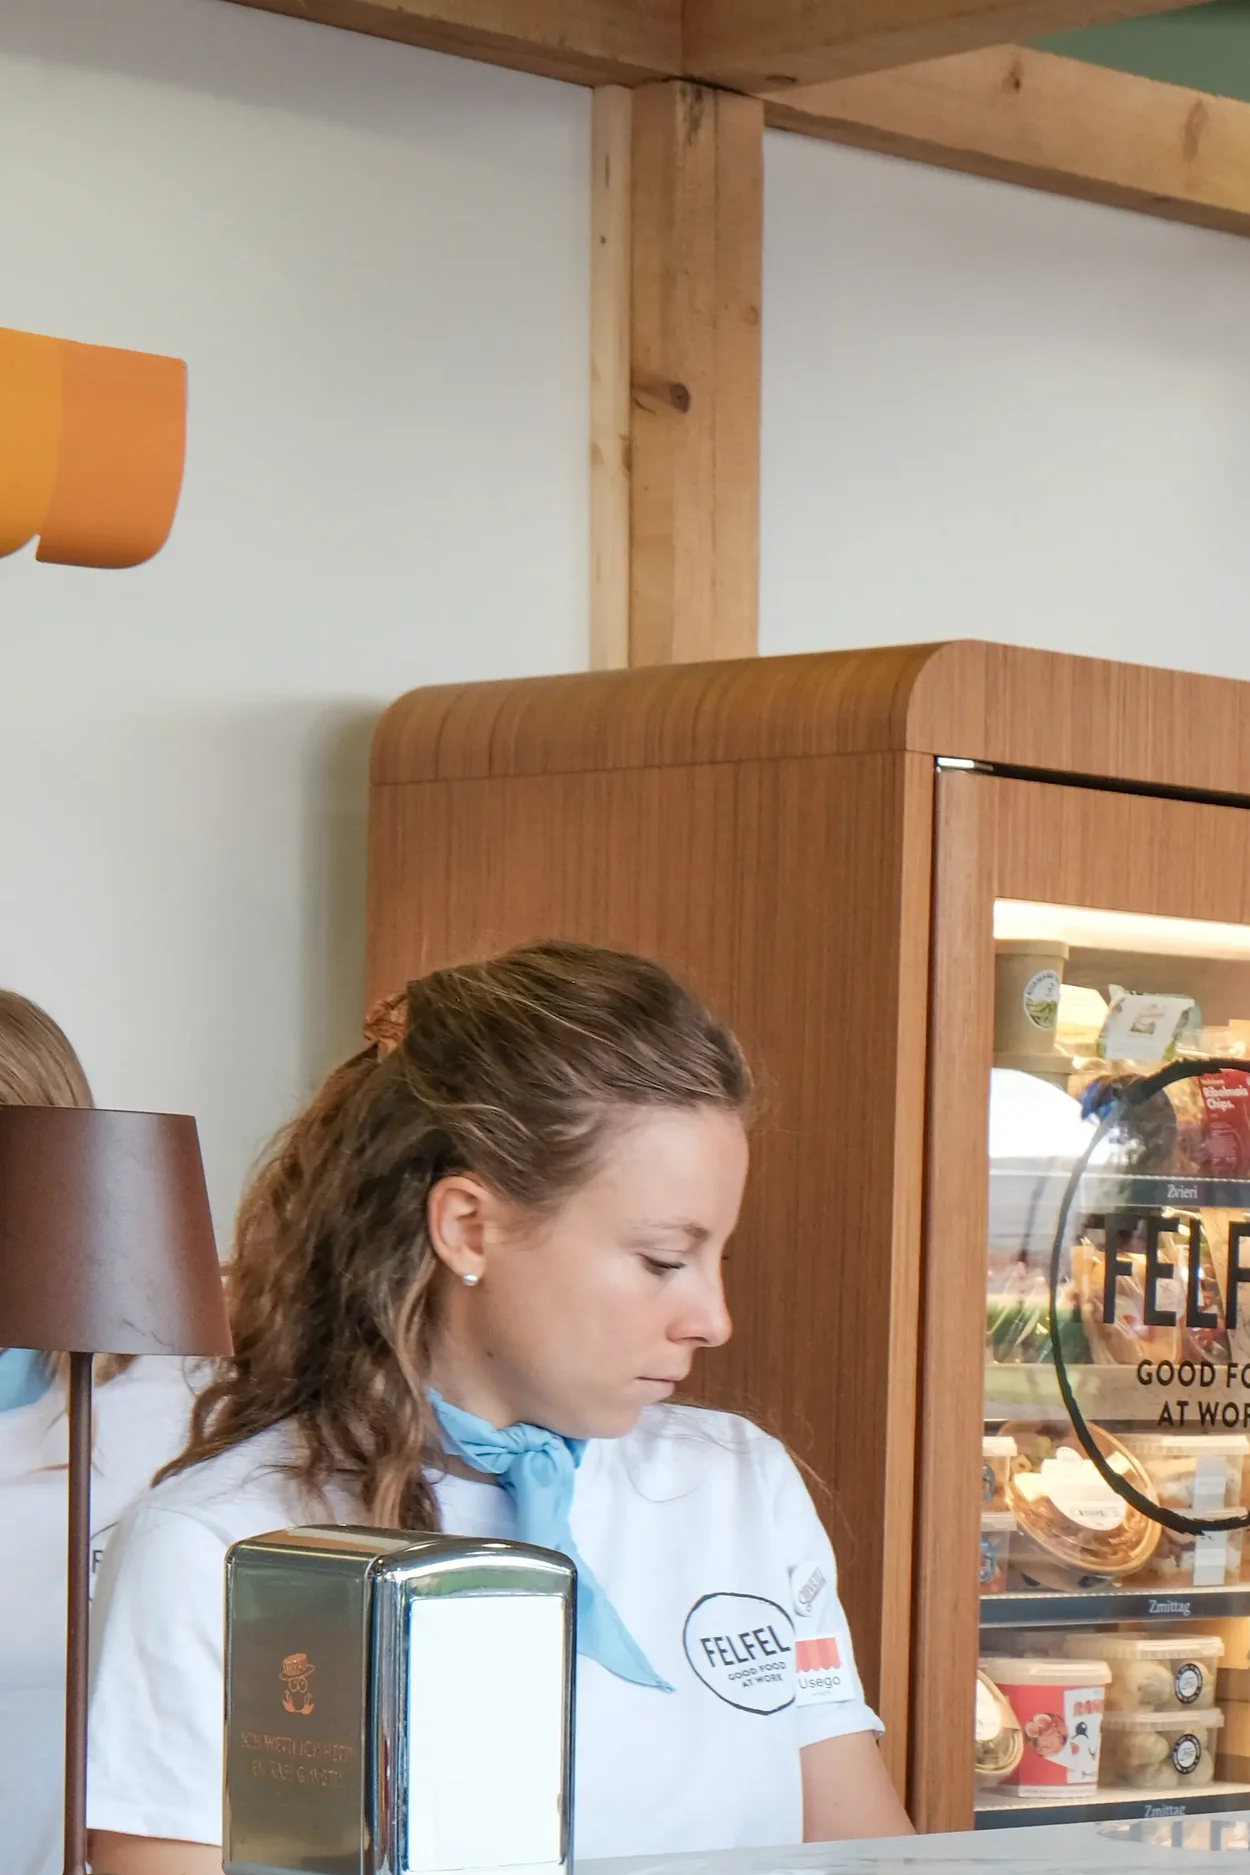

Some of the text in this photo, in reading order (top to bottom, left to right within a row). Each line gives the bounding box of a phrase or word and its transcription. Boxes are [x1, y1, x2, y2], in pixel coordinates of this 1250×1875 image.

[1167, 1184, 1198, 1200] Zvieri
[1136, 1359, 1216, 1387] GOOD
[1157, 1400, 1190, 1427] AT
[1149, 1599, 1191, 1616] Zmittag
[700, 1625, 792, 1668] FELFEL
[728, 1661, 787, 1682] GOOD FOOD
[742, 1673, 784, 1689] AT WORK
[797, 1675, 841, 1691] Usego
